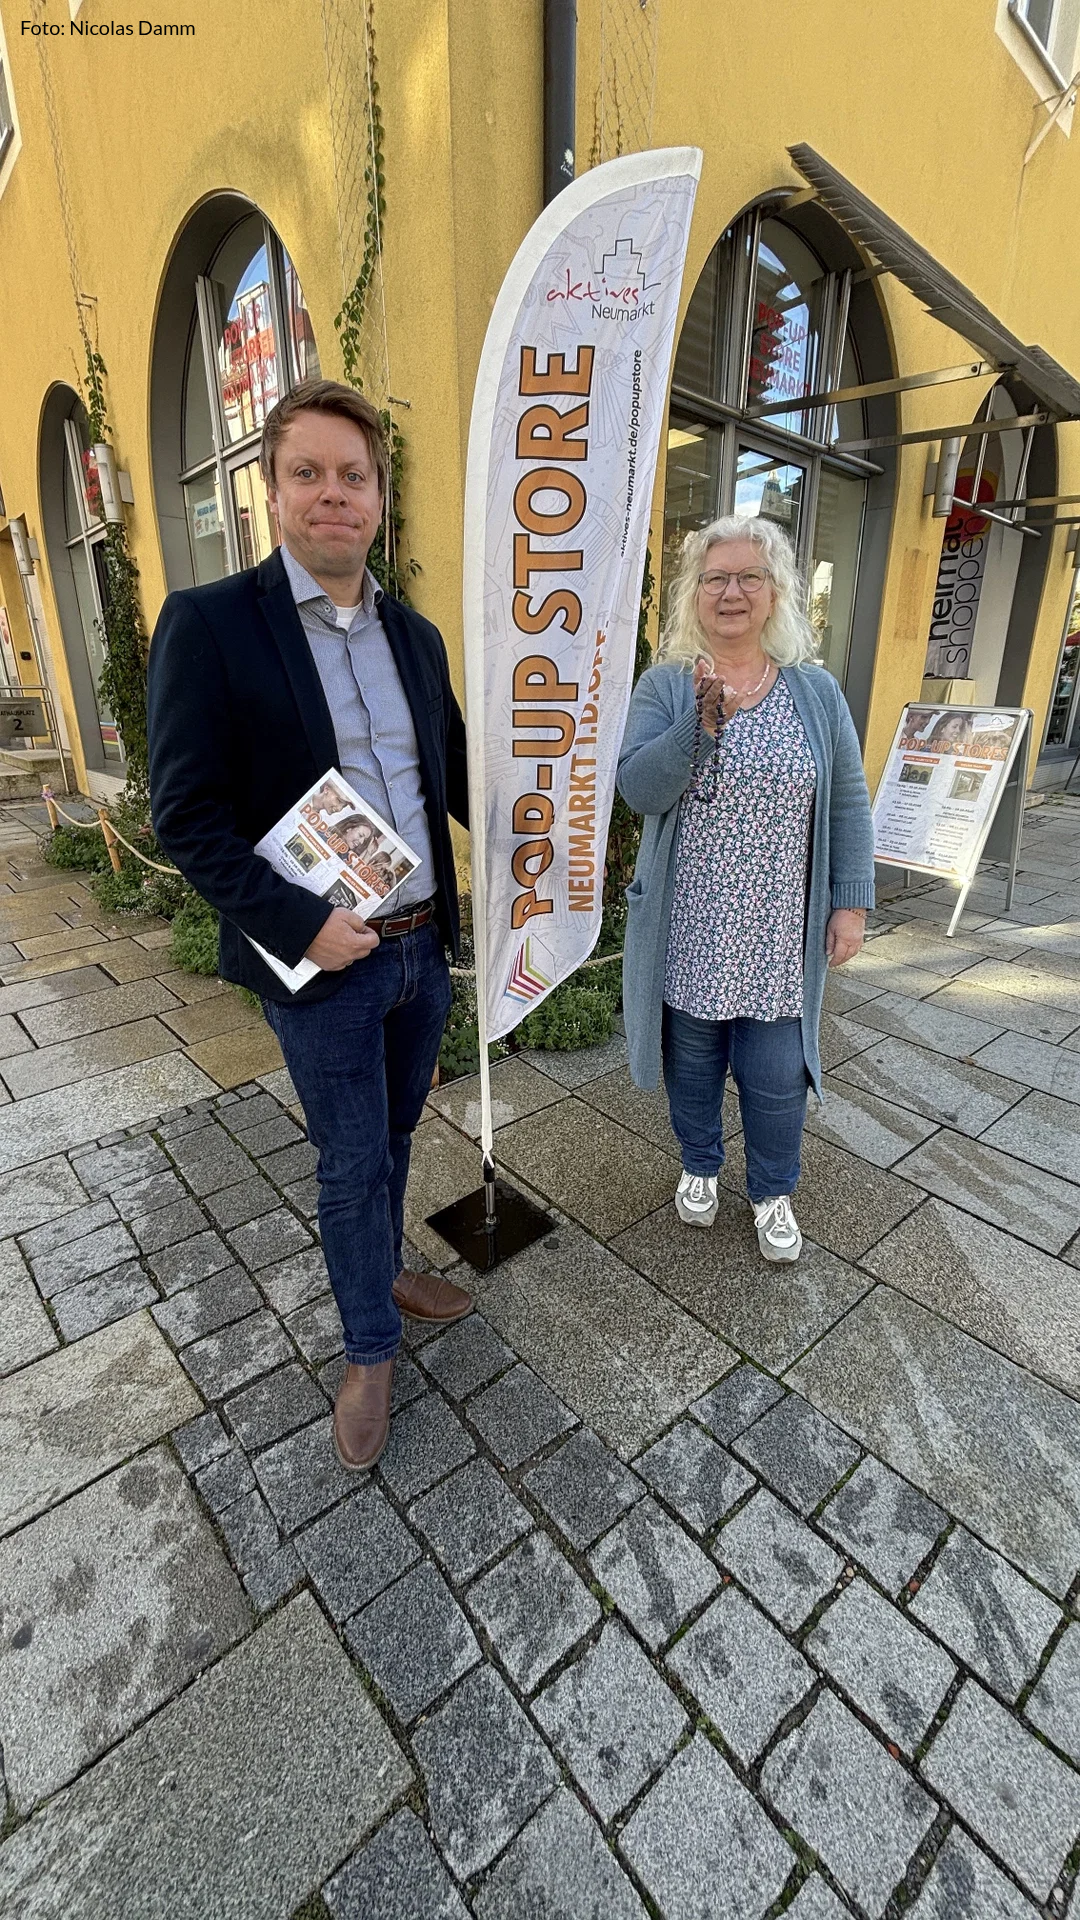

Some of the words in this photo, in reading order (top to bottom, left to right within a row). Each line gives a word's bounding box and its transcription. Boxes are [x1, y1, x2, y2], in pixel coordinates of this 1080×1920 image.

[546, 268, 639, 306] aktives
[591, 301, 656, 322] Neumarkt
[511, 345, 596, 637] STORE
[620, 350, 643, 558] aktives-neumarkt.de/popupstore
[940, 514, 984, 664] shoppen
[13, 718, 24, 731] 2
[898, 737, 952, 754] POP-UP
[952, 742, 1009, 761] STORES
[300, 803, 350, 855] POP-UP
[345, 851, 391, 897] STORES
[510, 654, 580, 930] POP-UP
[568, 753, 598, 912] NEUMARKT
